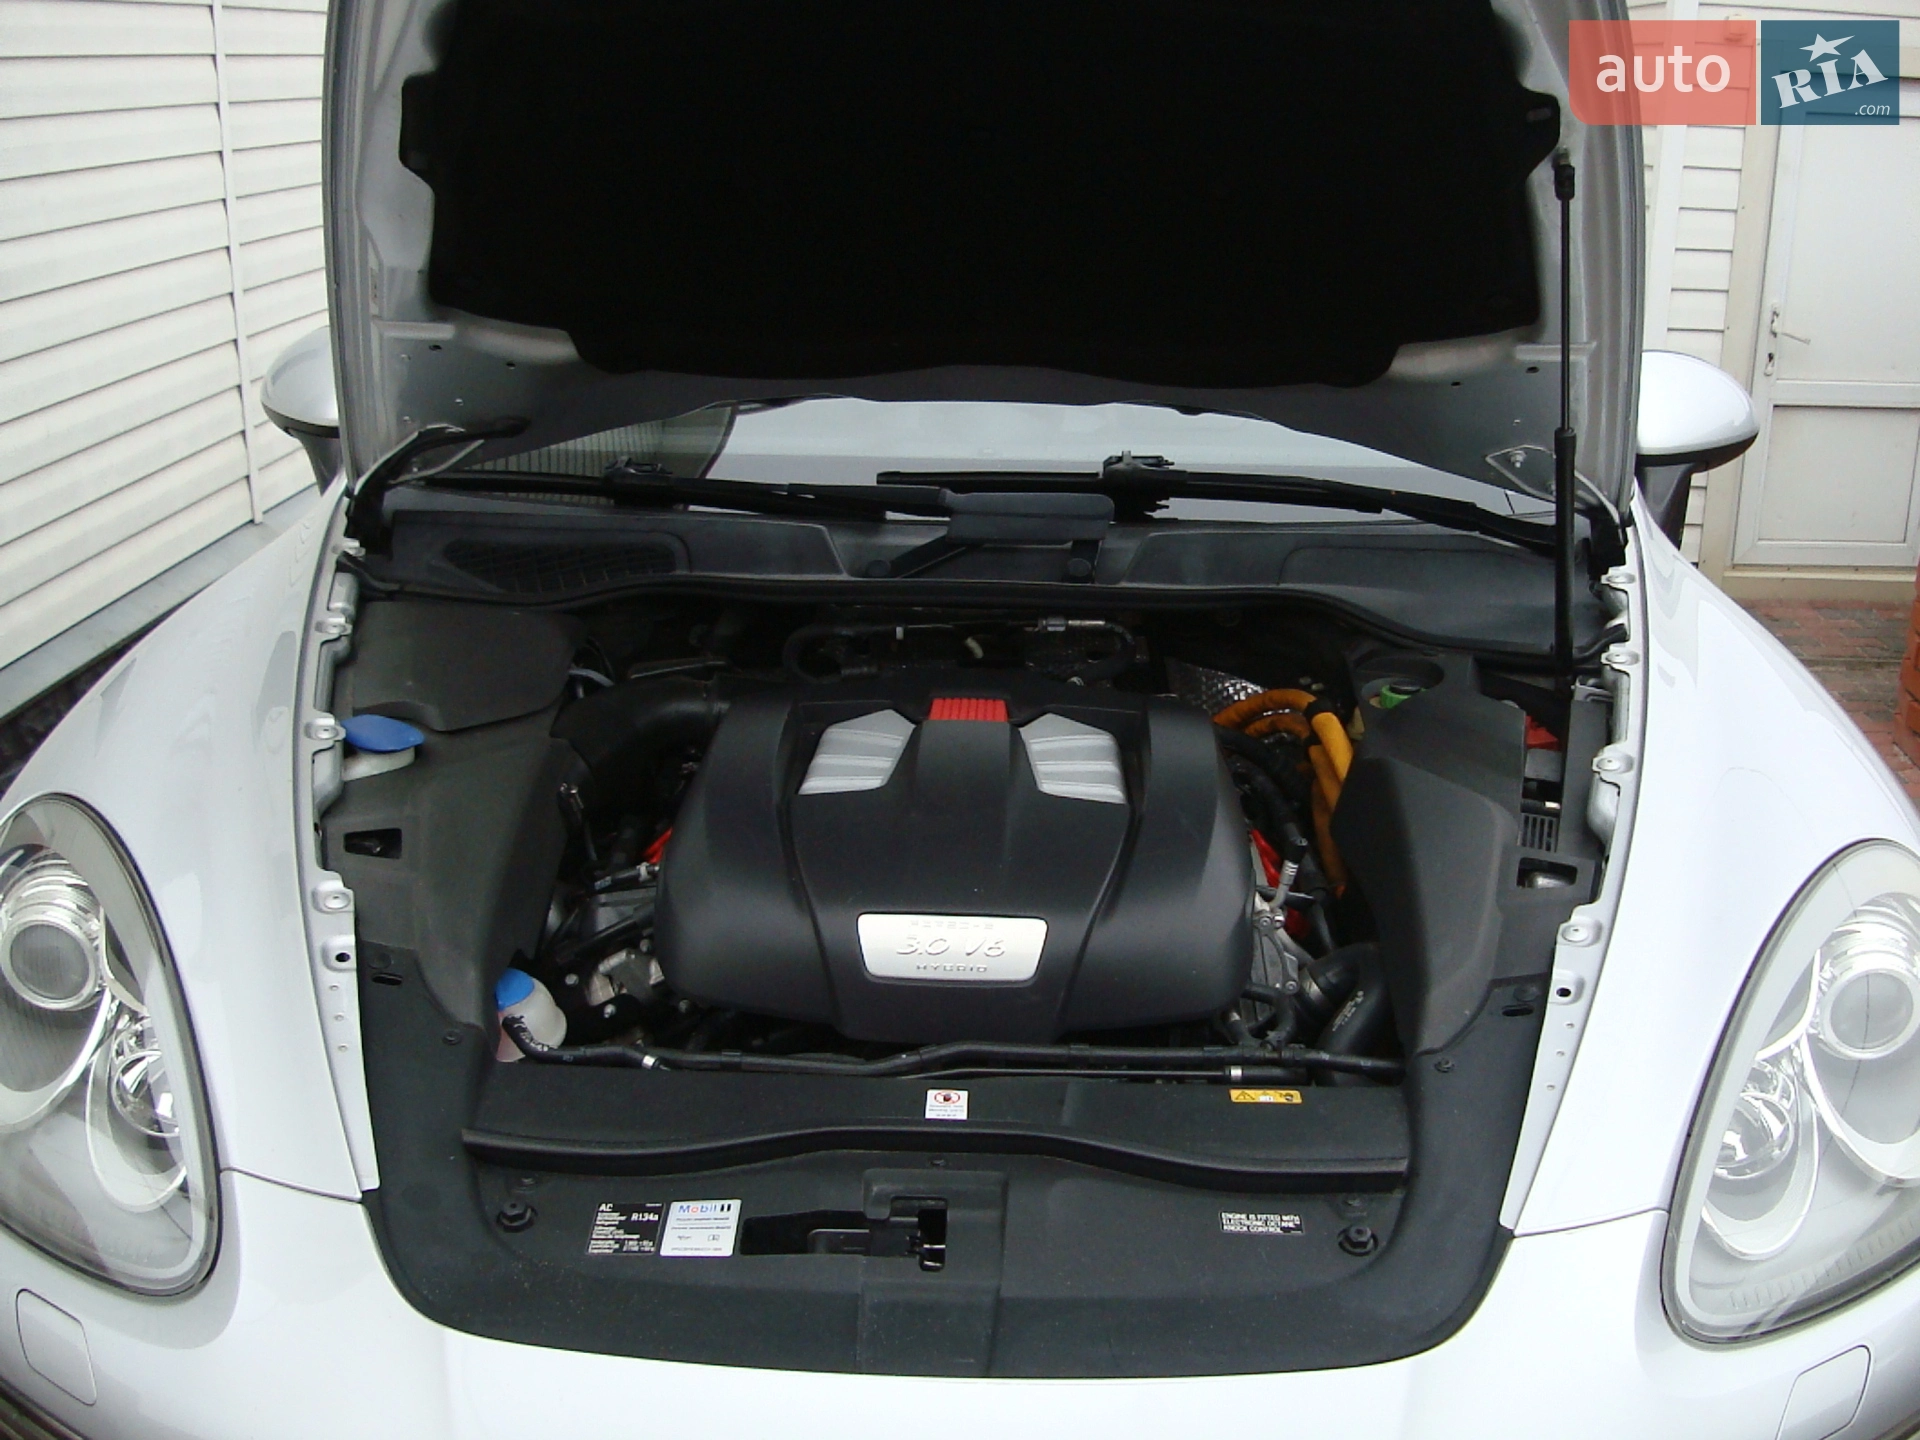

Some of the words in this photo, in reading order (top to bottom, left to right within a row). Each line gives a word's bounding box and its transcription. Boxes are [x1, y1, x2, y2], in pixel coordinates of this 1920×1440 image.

[896, 934, 951, 956] 3.0
[965, 937, 1006, 958] V6
[915, 963, 988, 973] HYBRID
[599, 1203, 614, 1212] AC
[678, 1204, 717, 1213] Mobil
[631, 1212, 659, 1222] R134a
